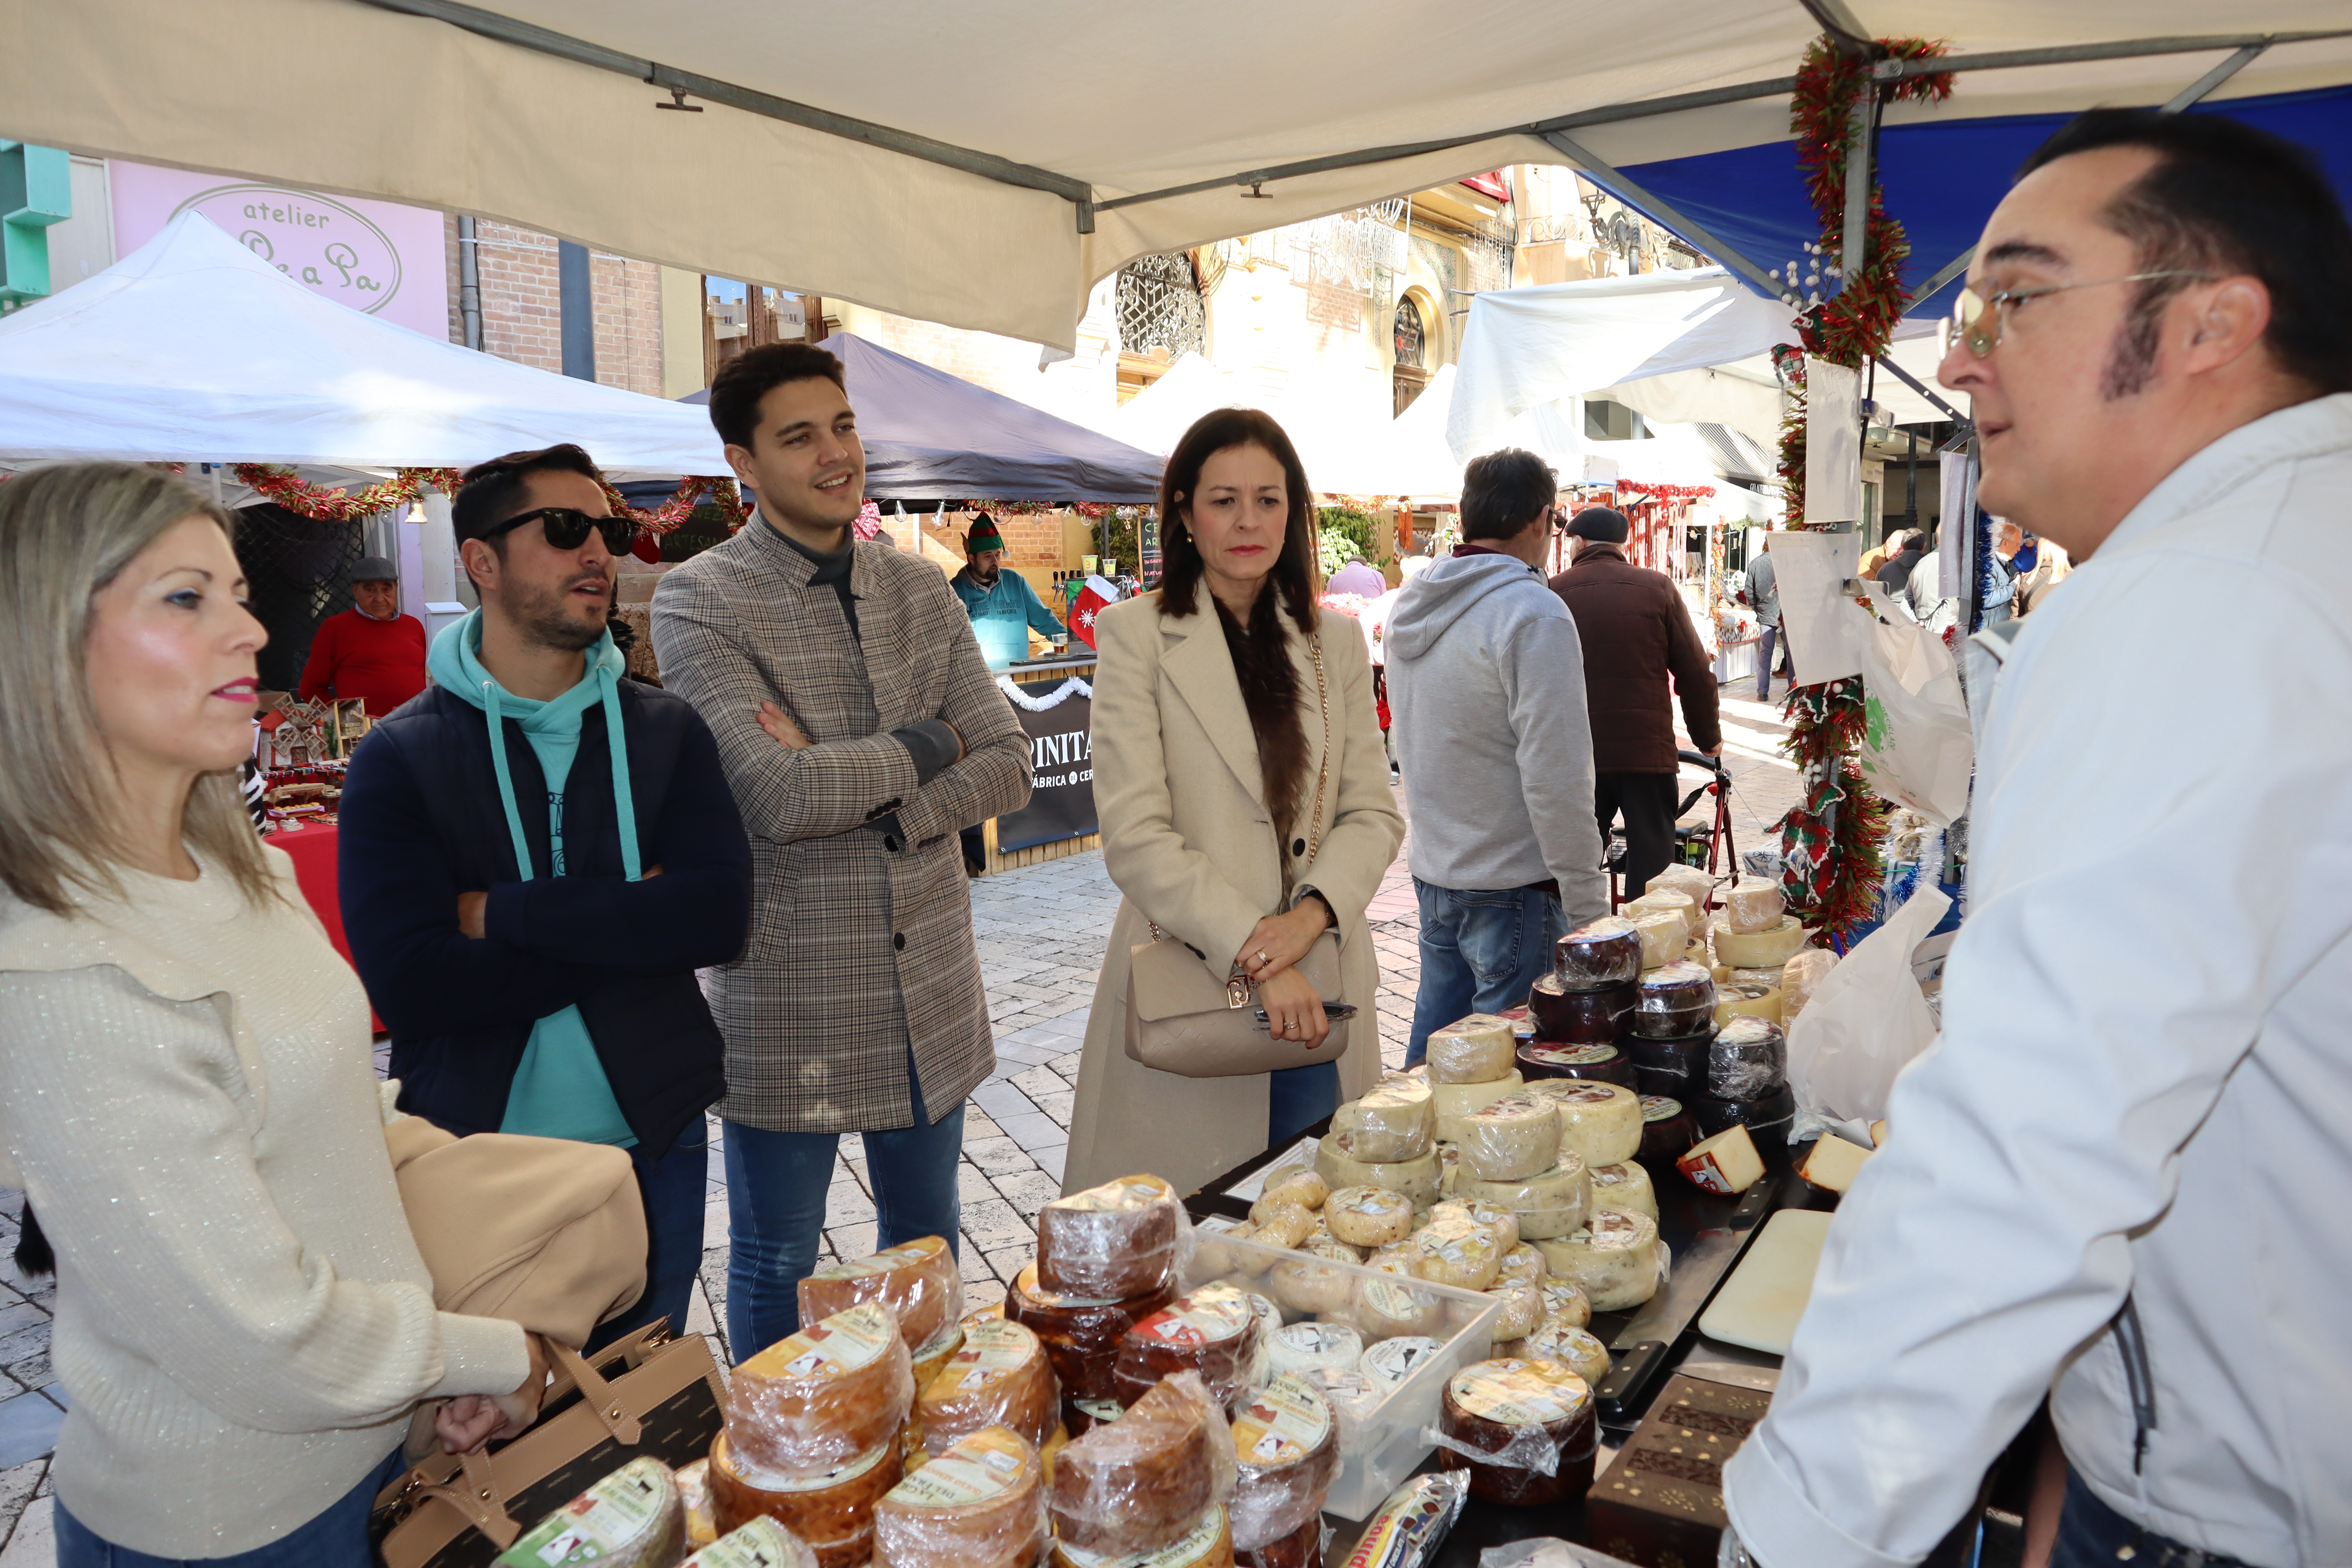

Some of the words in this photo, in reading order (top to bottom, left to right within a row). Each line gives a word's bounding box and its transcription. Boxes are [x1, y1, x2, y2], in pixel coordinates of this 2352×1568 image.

[243, 202, 329, 229] atelier
[1032, 774, 1066, 788] ÁBRICA
[935, 1488, 956, 1500] DEL
[953, 1480, 982, 1496] QUESO
[1389, 1537, 1405, 1568] CHOCOLATE
